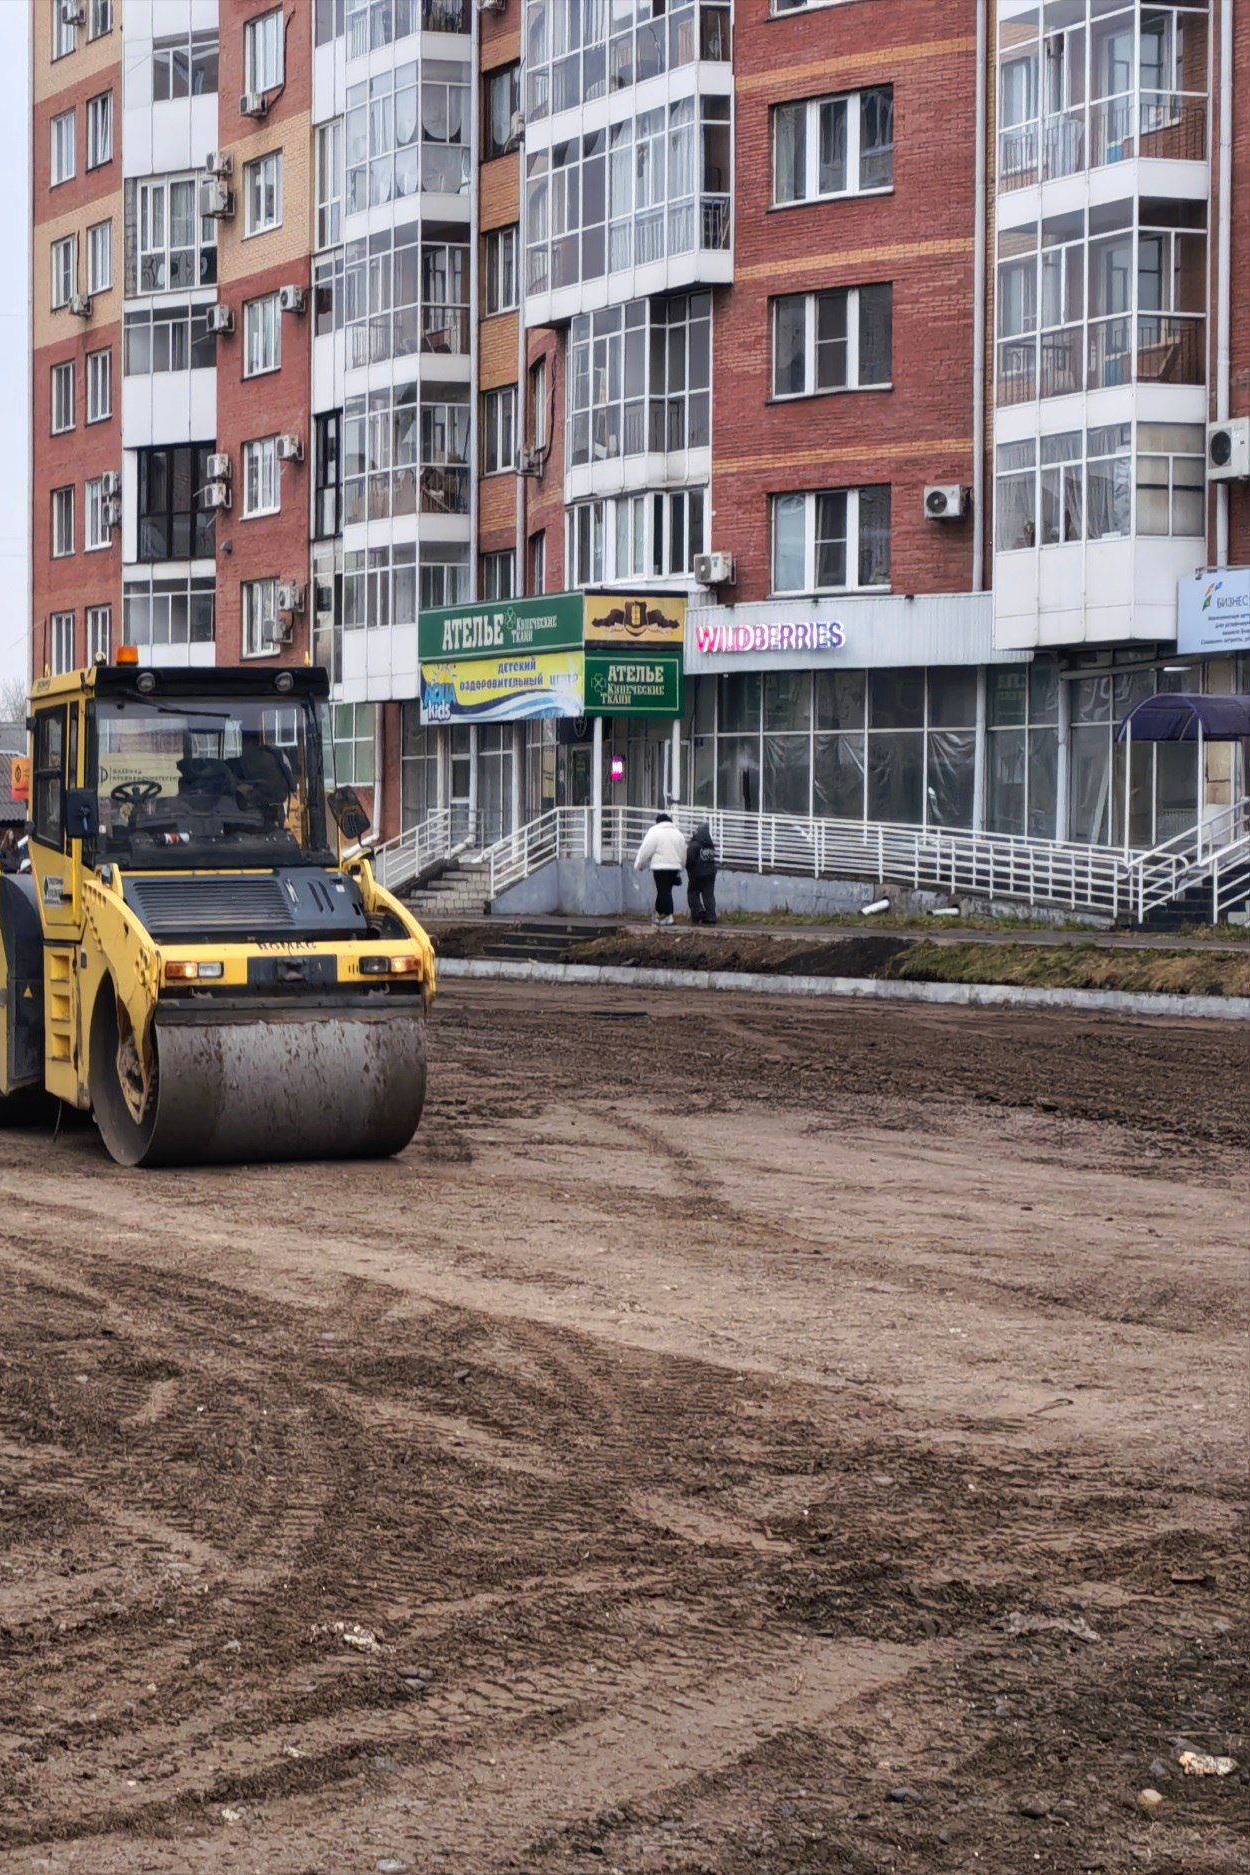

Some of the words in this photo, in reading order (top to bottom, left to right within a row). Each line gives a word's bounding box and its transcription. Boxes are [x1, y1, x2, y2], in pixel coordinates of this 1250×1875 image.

[442, 613, 504, 651] АТЕЛЬЕ
[695, 621, 845, 652] WILDBERRIES
[498, 656, 536, 674] ДЕТСКИЙ
[607, 665, 664, 683] АТЕЛЬЕ
[459, 672, 543, 691] ОЗДОРОВИТЕЛЬНЫЙ
[428, 699, 450, 720] kids
